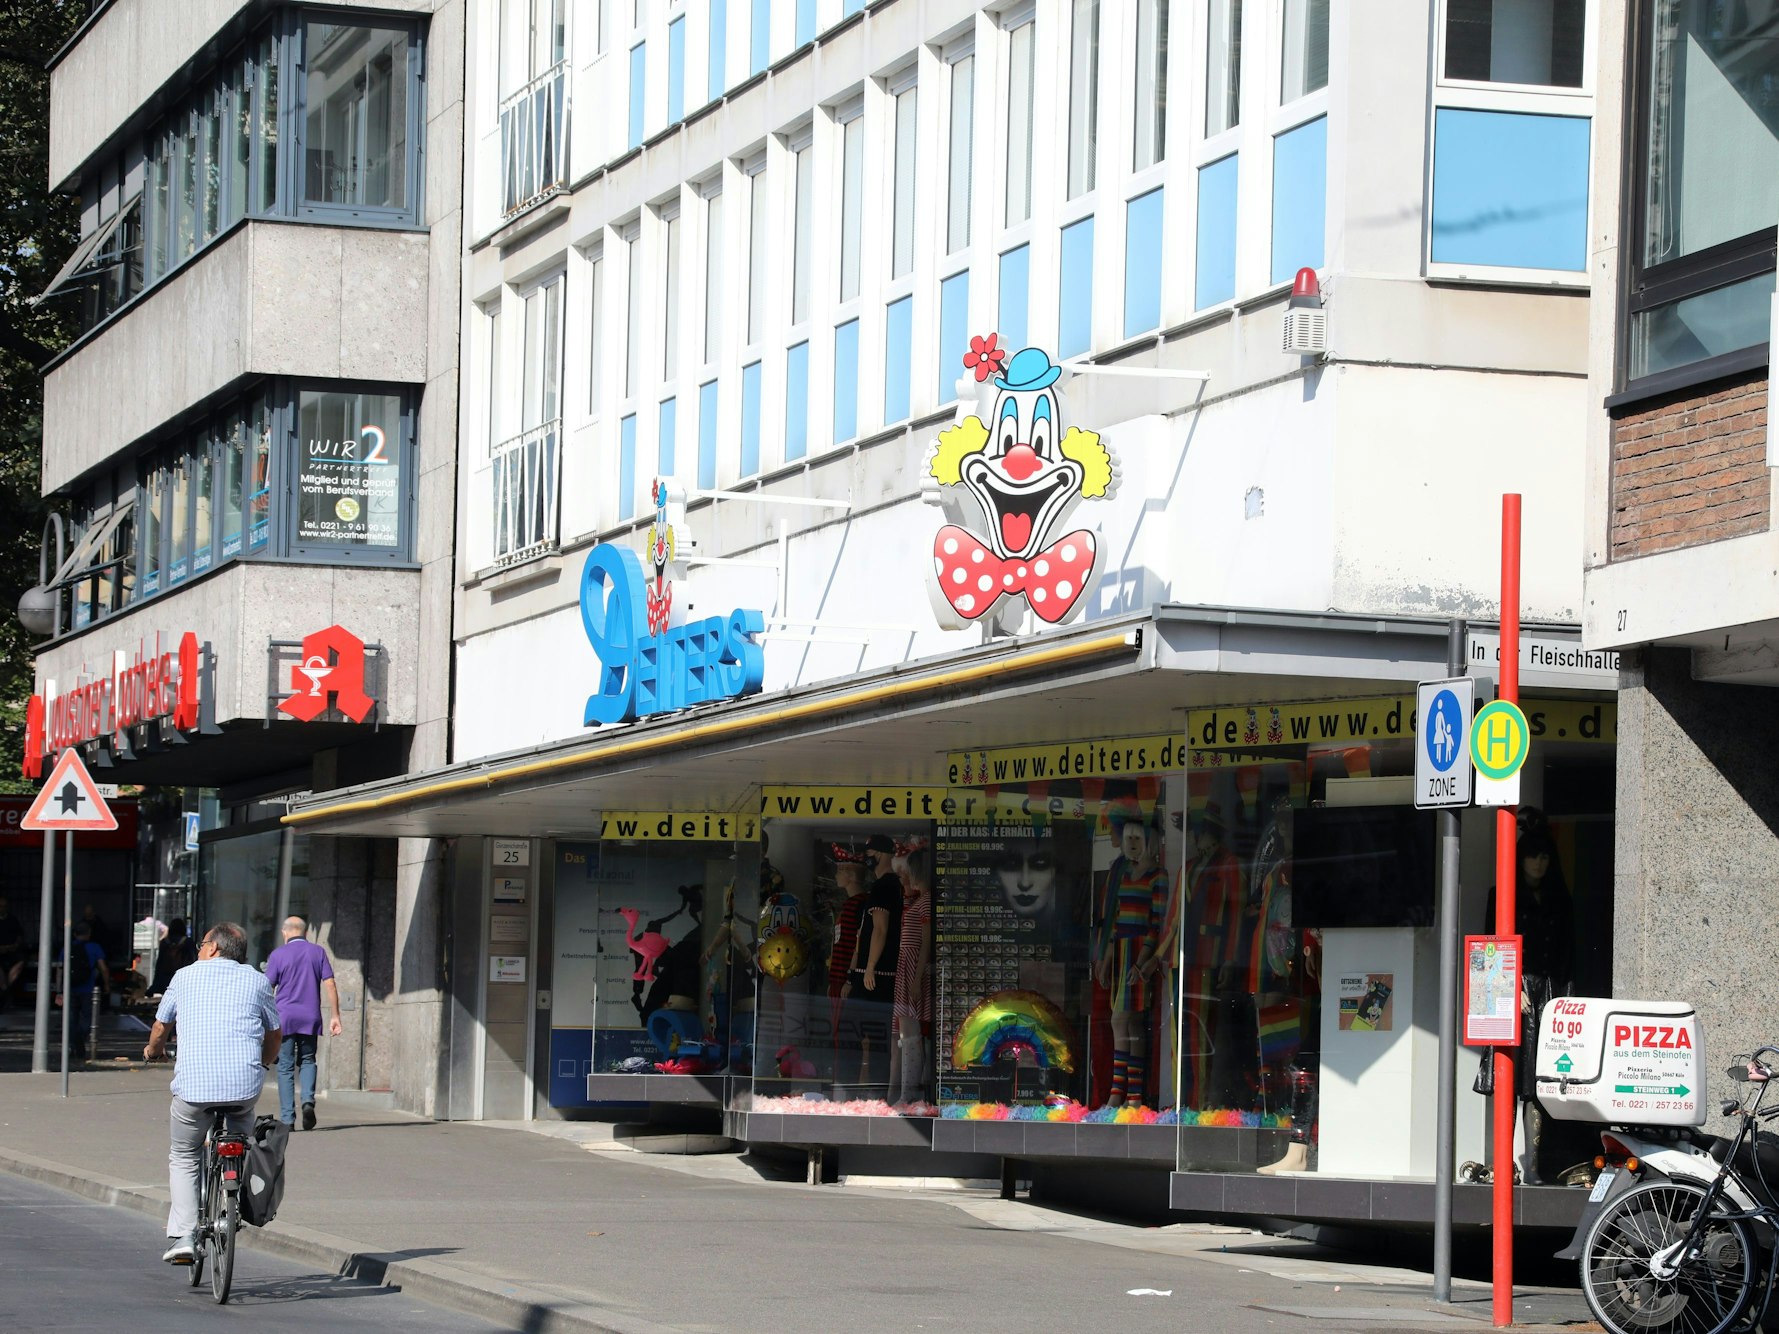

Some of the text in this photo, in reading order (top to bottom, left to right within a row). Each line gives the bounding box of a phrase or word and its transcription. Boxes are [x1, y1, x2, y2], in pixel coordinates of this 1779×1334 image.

[309, 425, 388, 464] WIR 2
[300, 474, 397, 488] Mitglied und geprüft
[302, 485, 394, 497] vom Berufsverband
[304, 521, 319, 529] Tel.
[320, 521, 340, 530] 0221
[348, 523, 354, 531] 9
[355, 523, 365, 531] 61
[368, 524, 378, 532] 90
[381, 524, 391, 532] 36
[299, 530, 396, 541] www.wir2-partnertreff.de
[1617, 609, 1627, 632] 27
[579, 543, 765, 727] DEITERS
[1471, 640, 1485, 660] In
[1530, 644, 1620, 671] Fleischhalle
[1486, 719, 1511, 762] H
[994, 738, 1185, 780] www.deiters.de
[1429, 777, 1457, 798] ZONE
[951, 827, 968, 837] DER
[1000, 825, 1052, 837] ERHÄLTH
[503, 851, 519, 863] 25
[564, 852, 586, 864] Das
[1553, 999, 1586, 1015] Pizza
[1552, 1017, 1582, 1039] to go
[1614, 1025, 1692, 1049] PIZZA
[1613, 1049, 1691, 1060] aus dem Steinofen
[1618, 1071, 1639, 1080] Piccolo
[1640, 1072, 1661, 1081] Milano
[1633, 1086, 1670, 1094] STEINWEG
[1612, 1099, 1626, 1108] Tel.
[1628, 1100, 1648, 1109] 0221
[1655, 1101, 1671, 1110] 257
[1672, 1101, 1683, 1110] 23
